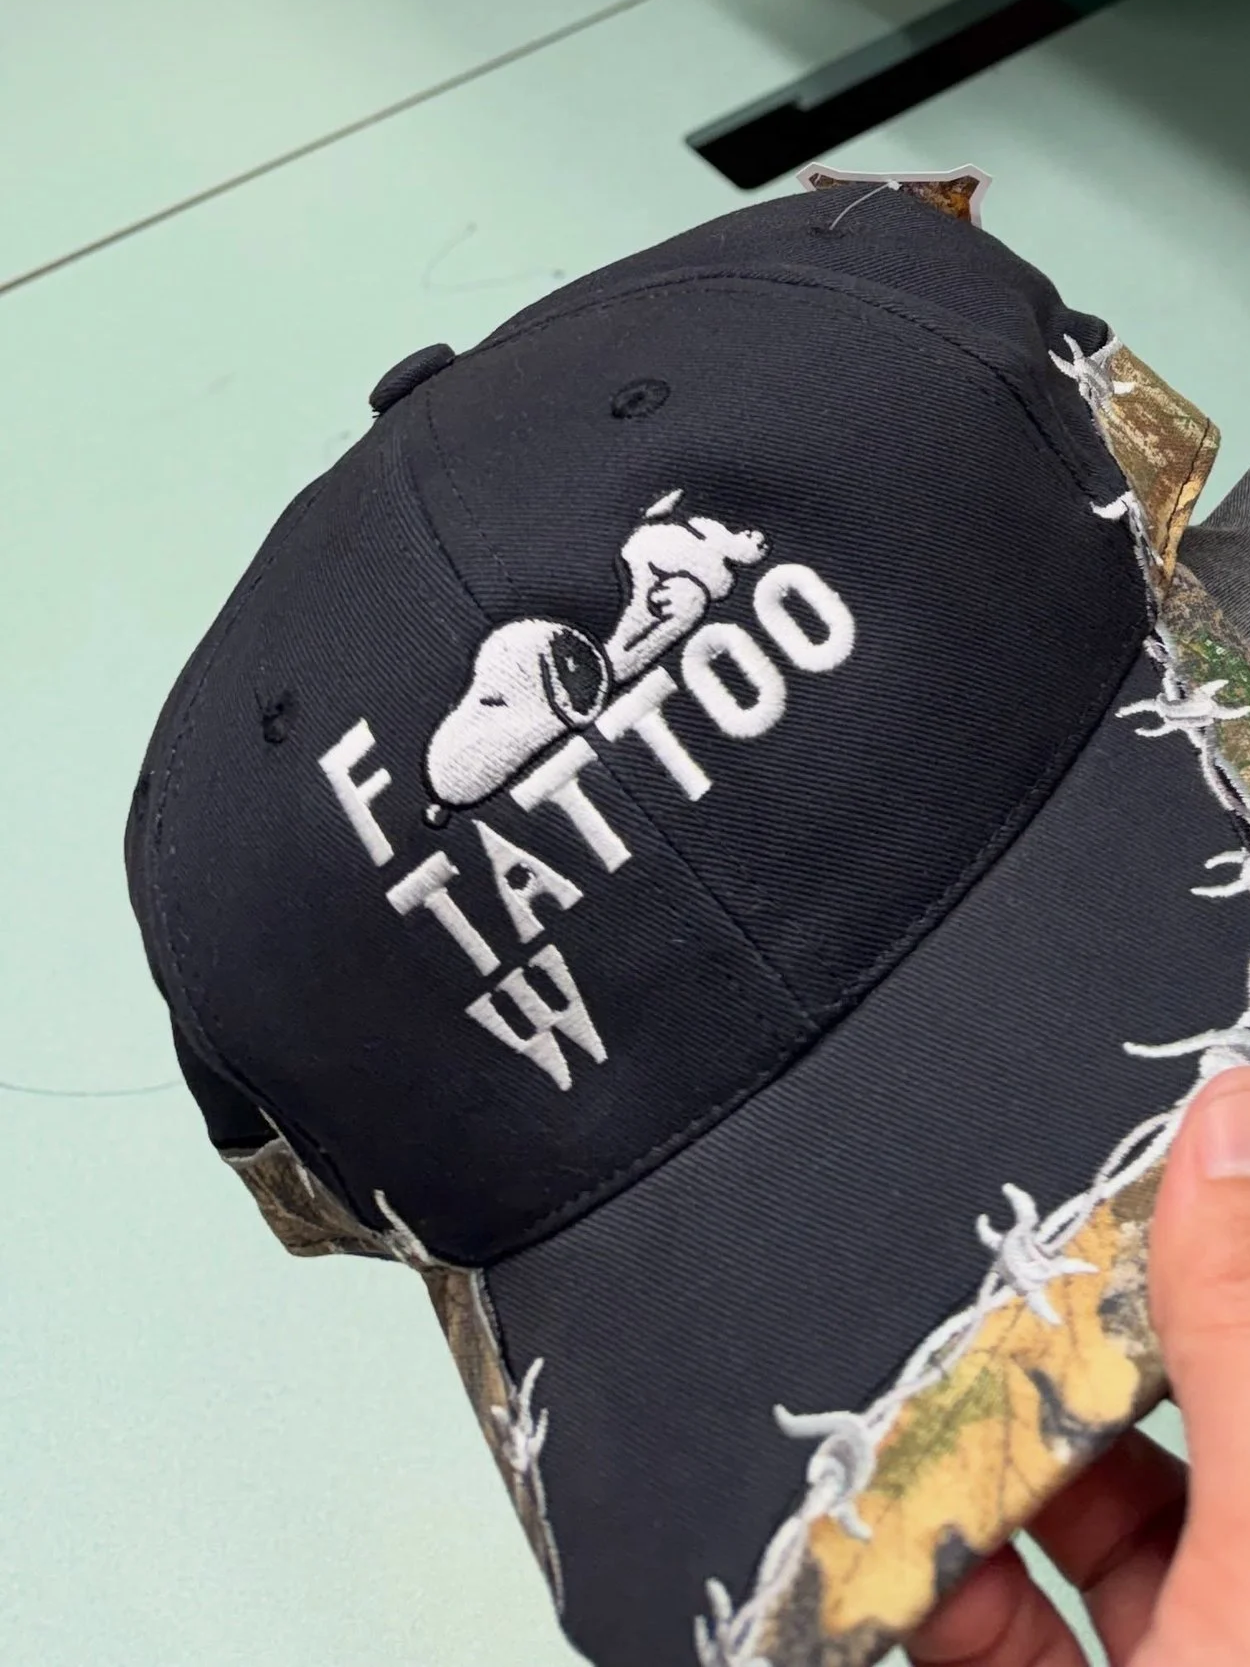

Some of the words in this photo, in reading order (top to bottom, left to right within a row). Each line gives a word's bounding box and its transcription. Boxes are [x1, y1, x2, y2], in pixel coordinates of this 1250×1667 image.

[317, 717, 394, 866] F
[386, 563, 856, 977] TATTOO
[464, 944, 608, 1091] W
